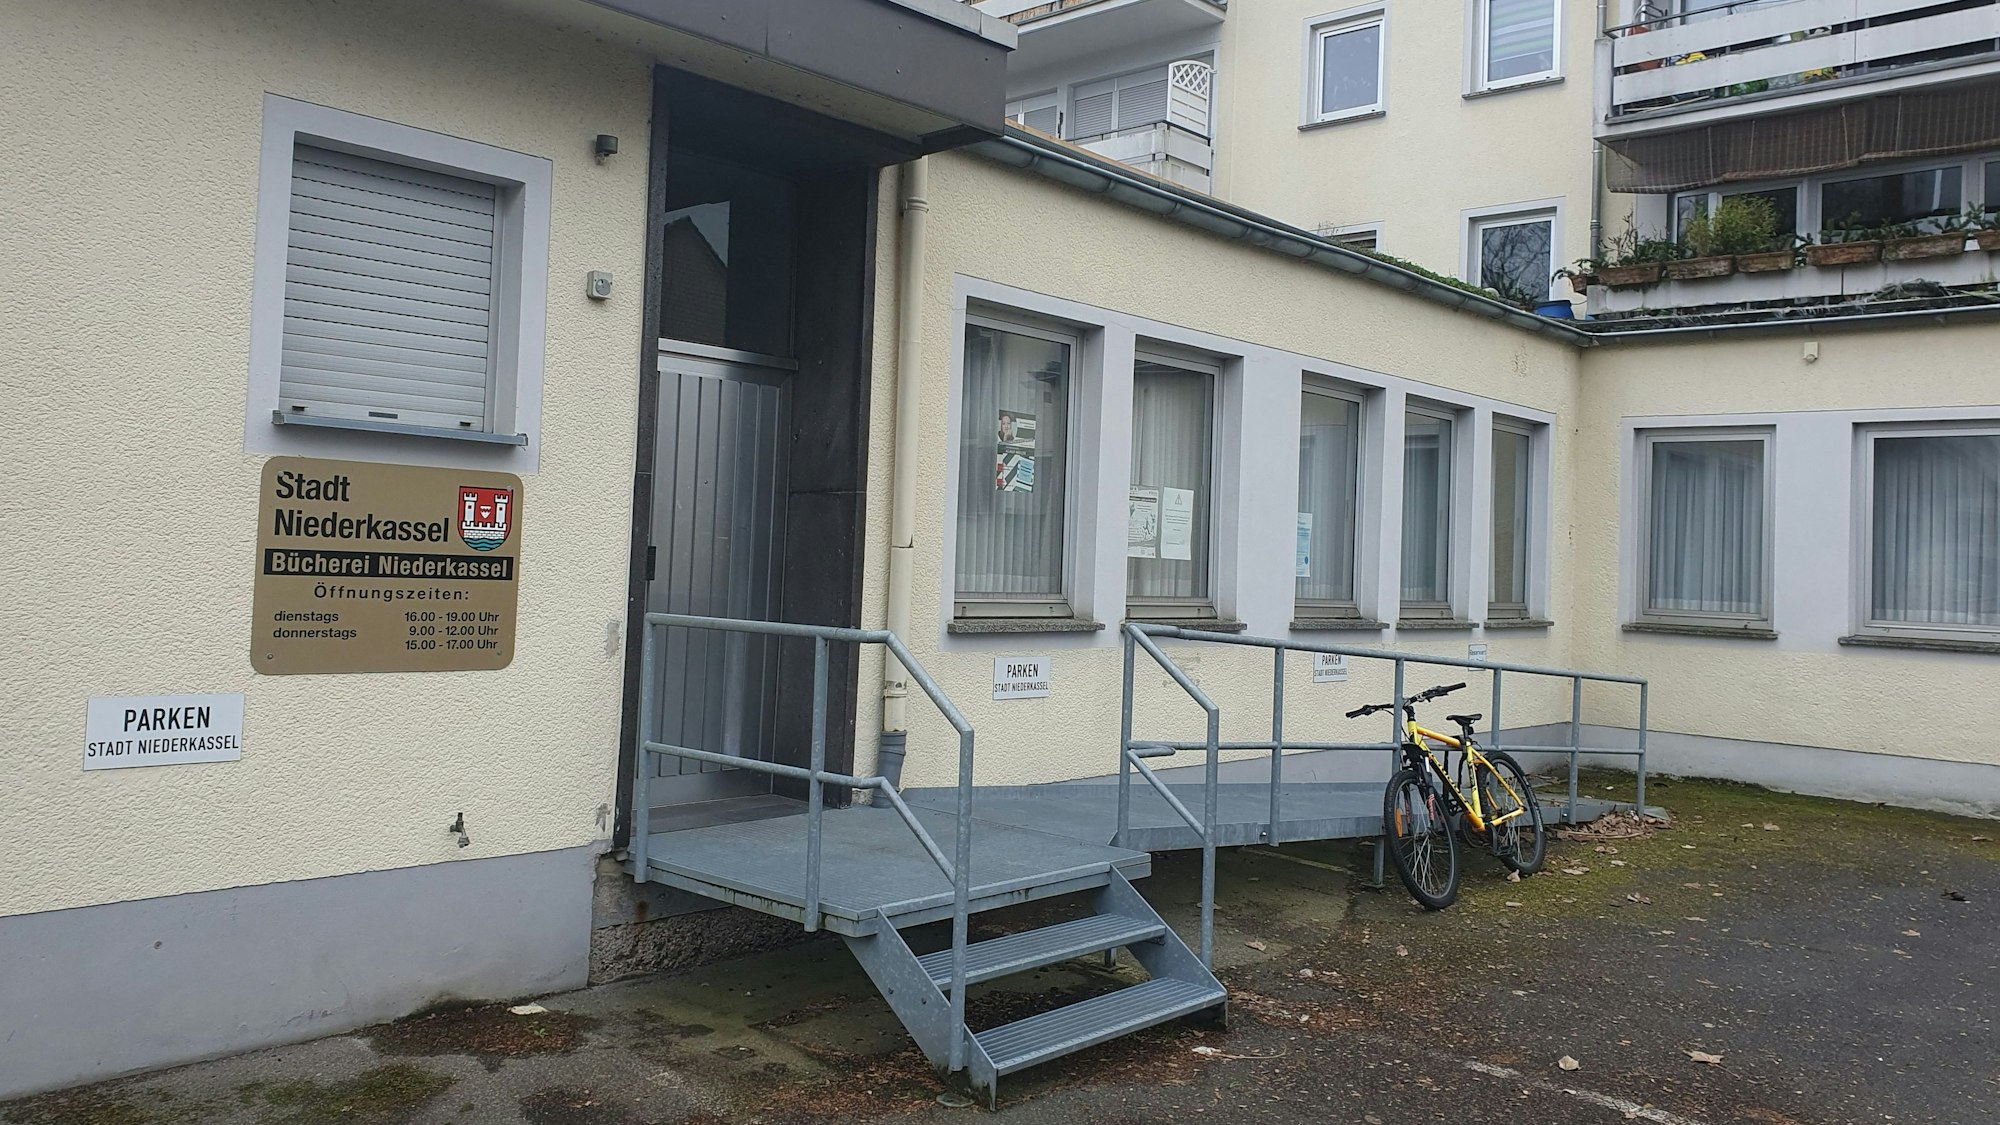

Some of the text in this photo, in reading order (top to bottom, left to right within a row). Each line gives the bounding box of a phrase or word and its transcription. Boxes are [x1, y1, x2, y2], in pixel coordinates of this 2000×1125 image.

[275, 470, 351, 502] Stadt
[273, 508, 450, 543] Niederkassel
[271, 551, 508, 578] Bücherei Niederkassel
[313, 582, 470, 602] Öffnungszeiten:
[273, 611, 340, 623] dienstags
[404, 612, 436, 622] 16.00
[445, 612, 476, 622] 19.00
[478, 612, 500, 622] Uhr
[272, 627, 358, 640] donnerstags
[408, 626, 436, 636] 9.00
[444, 626, 476, 636] 12.00
[477, 626, 499, 636] Uhr
[405, 640, 436, 650] 15.00
[445, 640, 475, 650] 17.00
[476, 640, 499, 650] Uhr
[1007, 664, 1039, 678] PARKEN
[994, 681, 1049, 693] STADT NIEDERKASSEL
[123, 706, 211, 732] PARKEN
[88, 735, 239, 757] STADT NIEDERKASSEL
